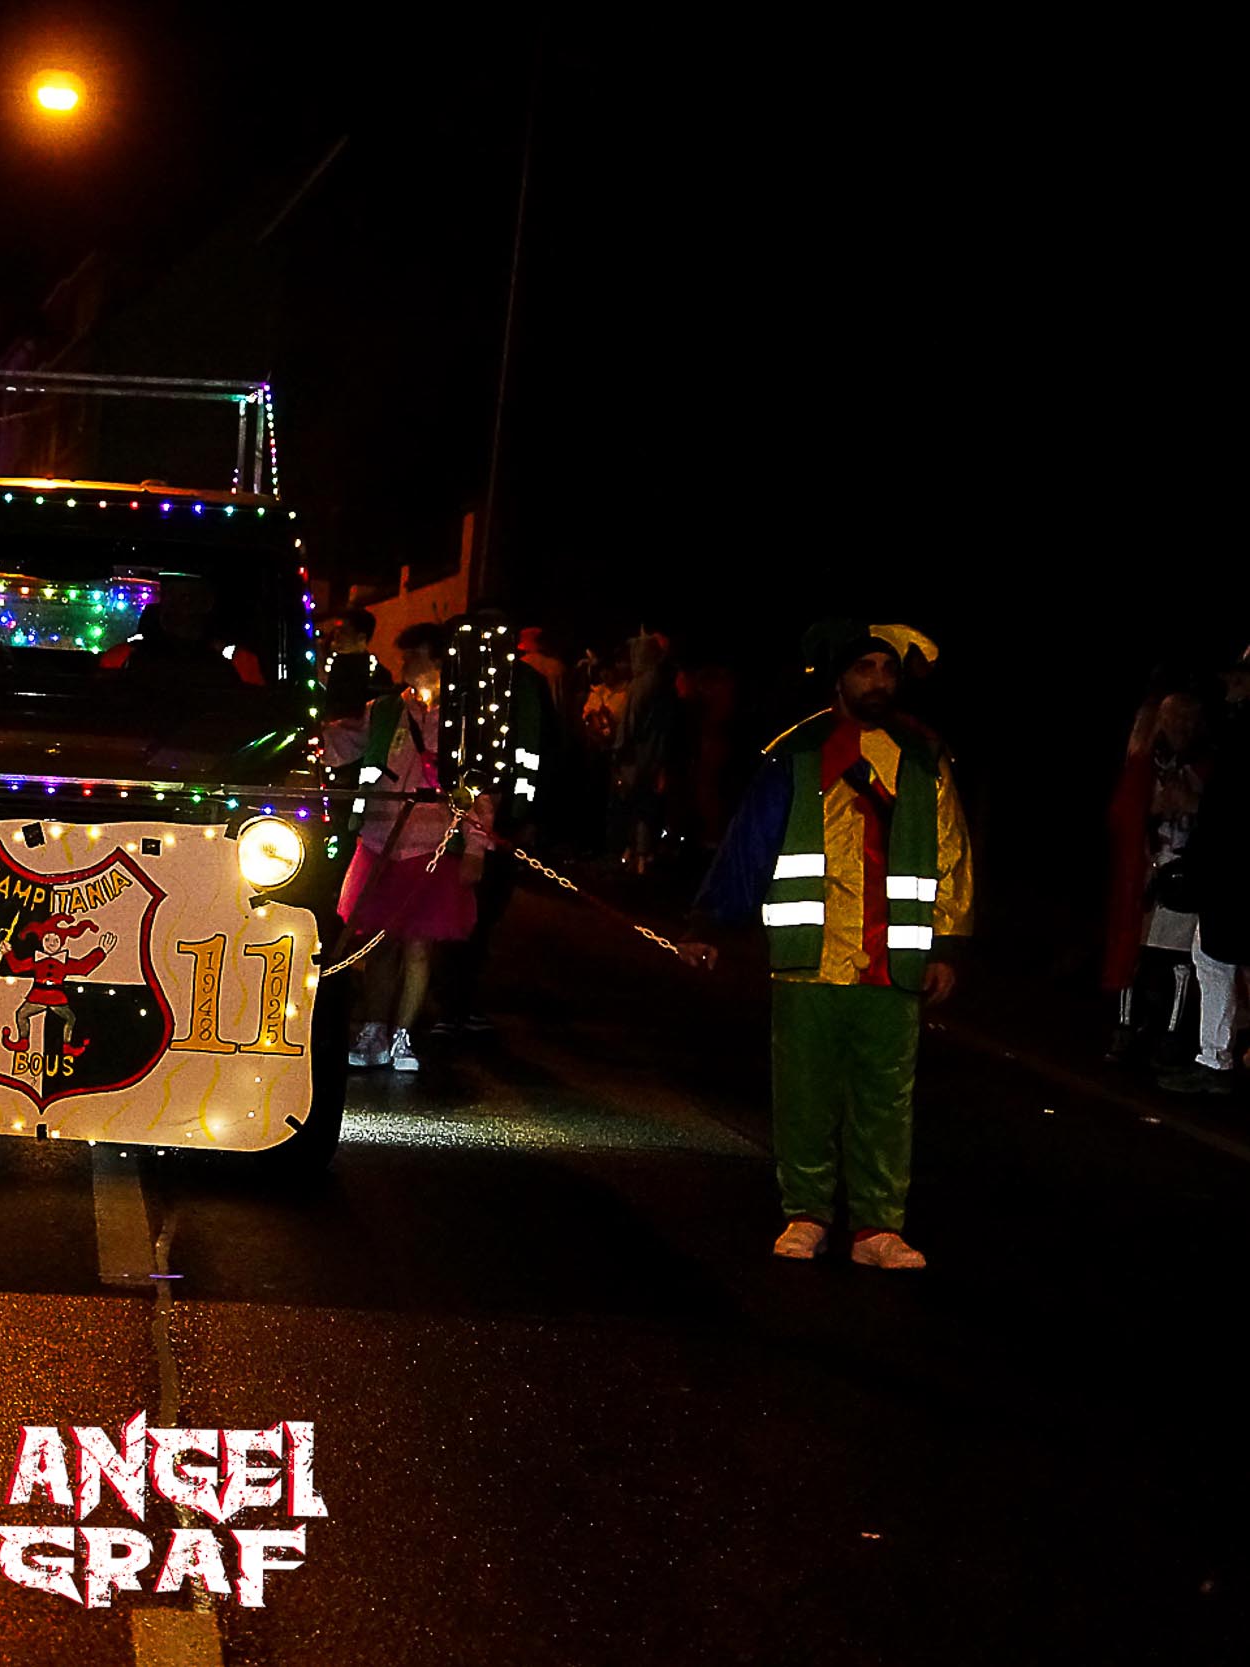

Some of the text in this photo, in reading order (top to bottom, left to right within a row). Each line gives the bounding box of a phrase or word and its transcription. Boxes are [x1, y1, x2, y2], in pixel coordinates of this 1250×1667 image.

[197, 951, 216, 1042] 1948
[266, 951, 286, 1044] 2025
[12, 1051, 74, 1077] BOUS
